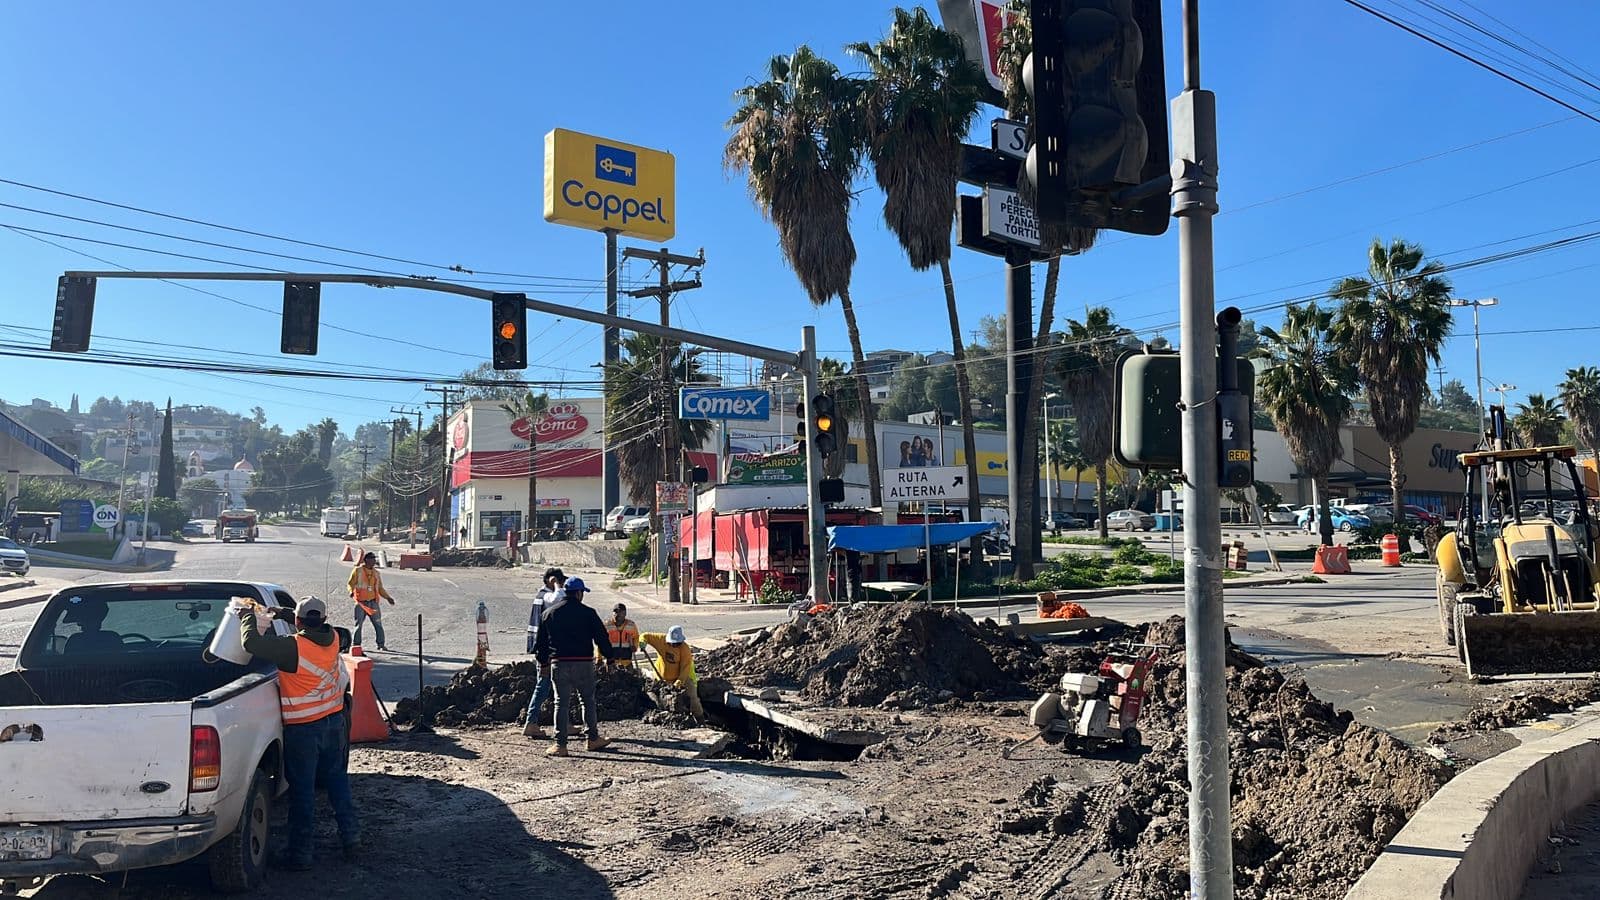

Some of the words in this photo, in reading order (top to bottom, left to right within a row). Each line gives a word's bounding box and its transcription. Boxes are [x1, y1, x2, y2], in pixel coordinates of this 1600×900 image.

[562, 179, 667, 224] Coppel
[683, 393, 765, 416] Comex
[517, 413, 577, 436] Roma
[898, 471, 928, 483] RUTA
[890, 485, 946, 497] ALTERNA
[96, 509, 117, 520] ON
